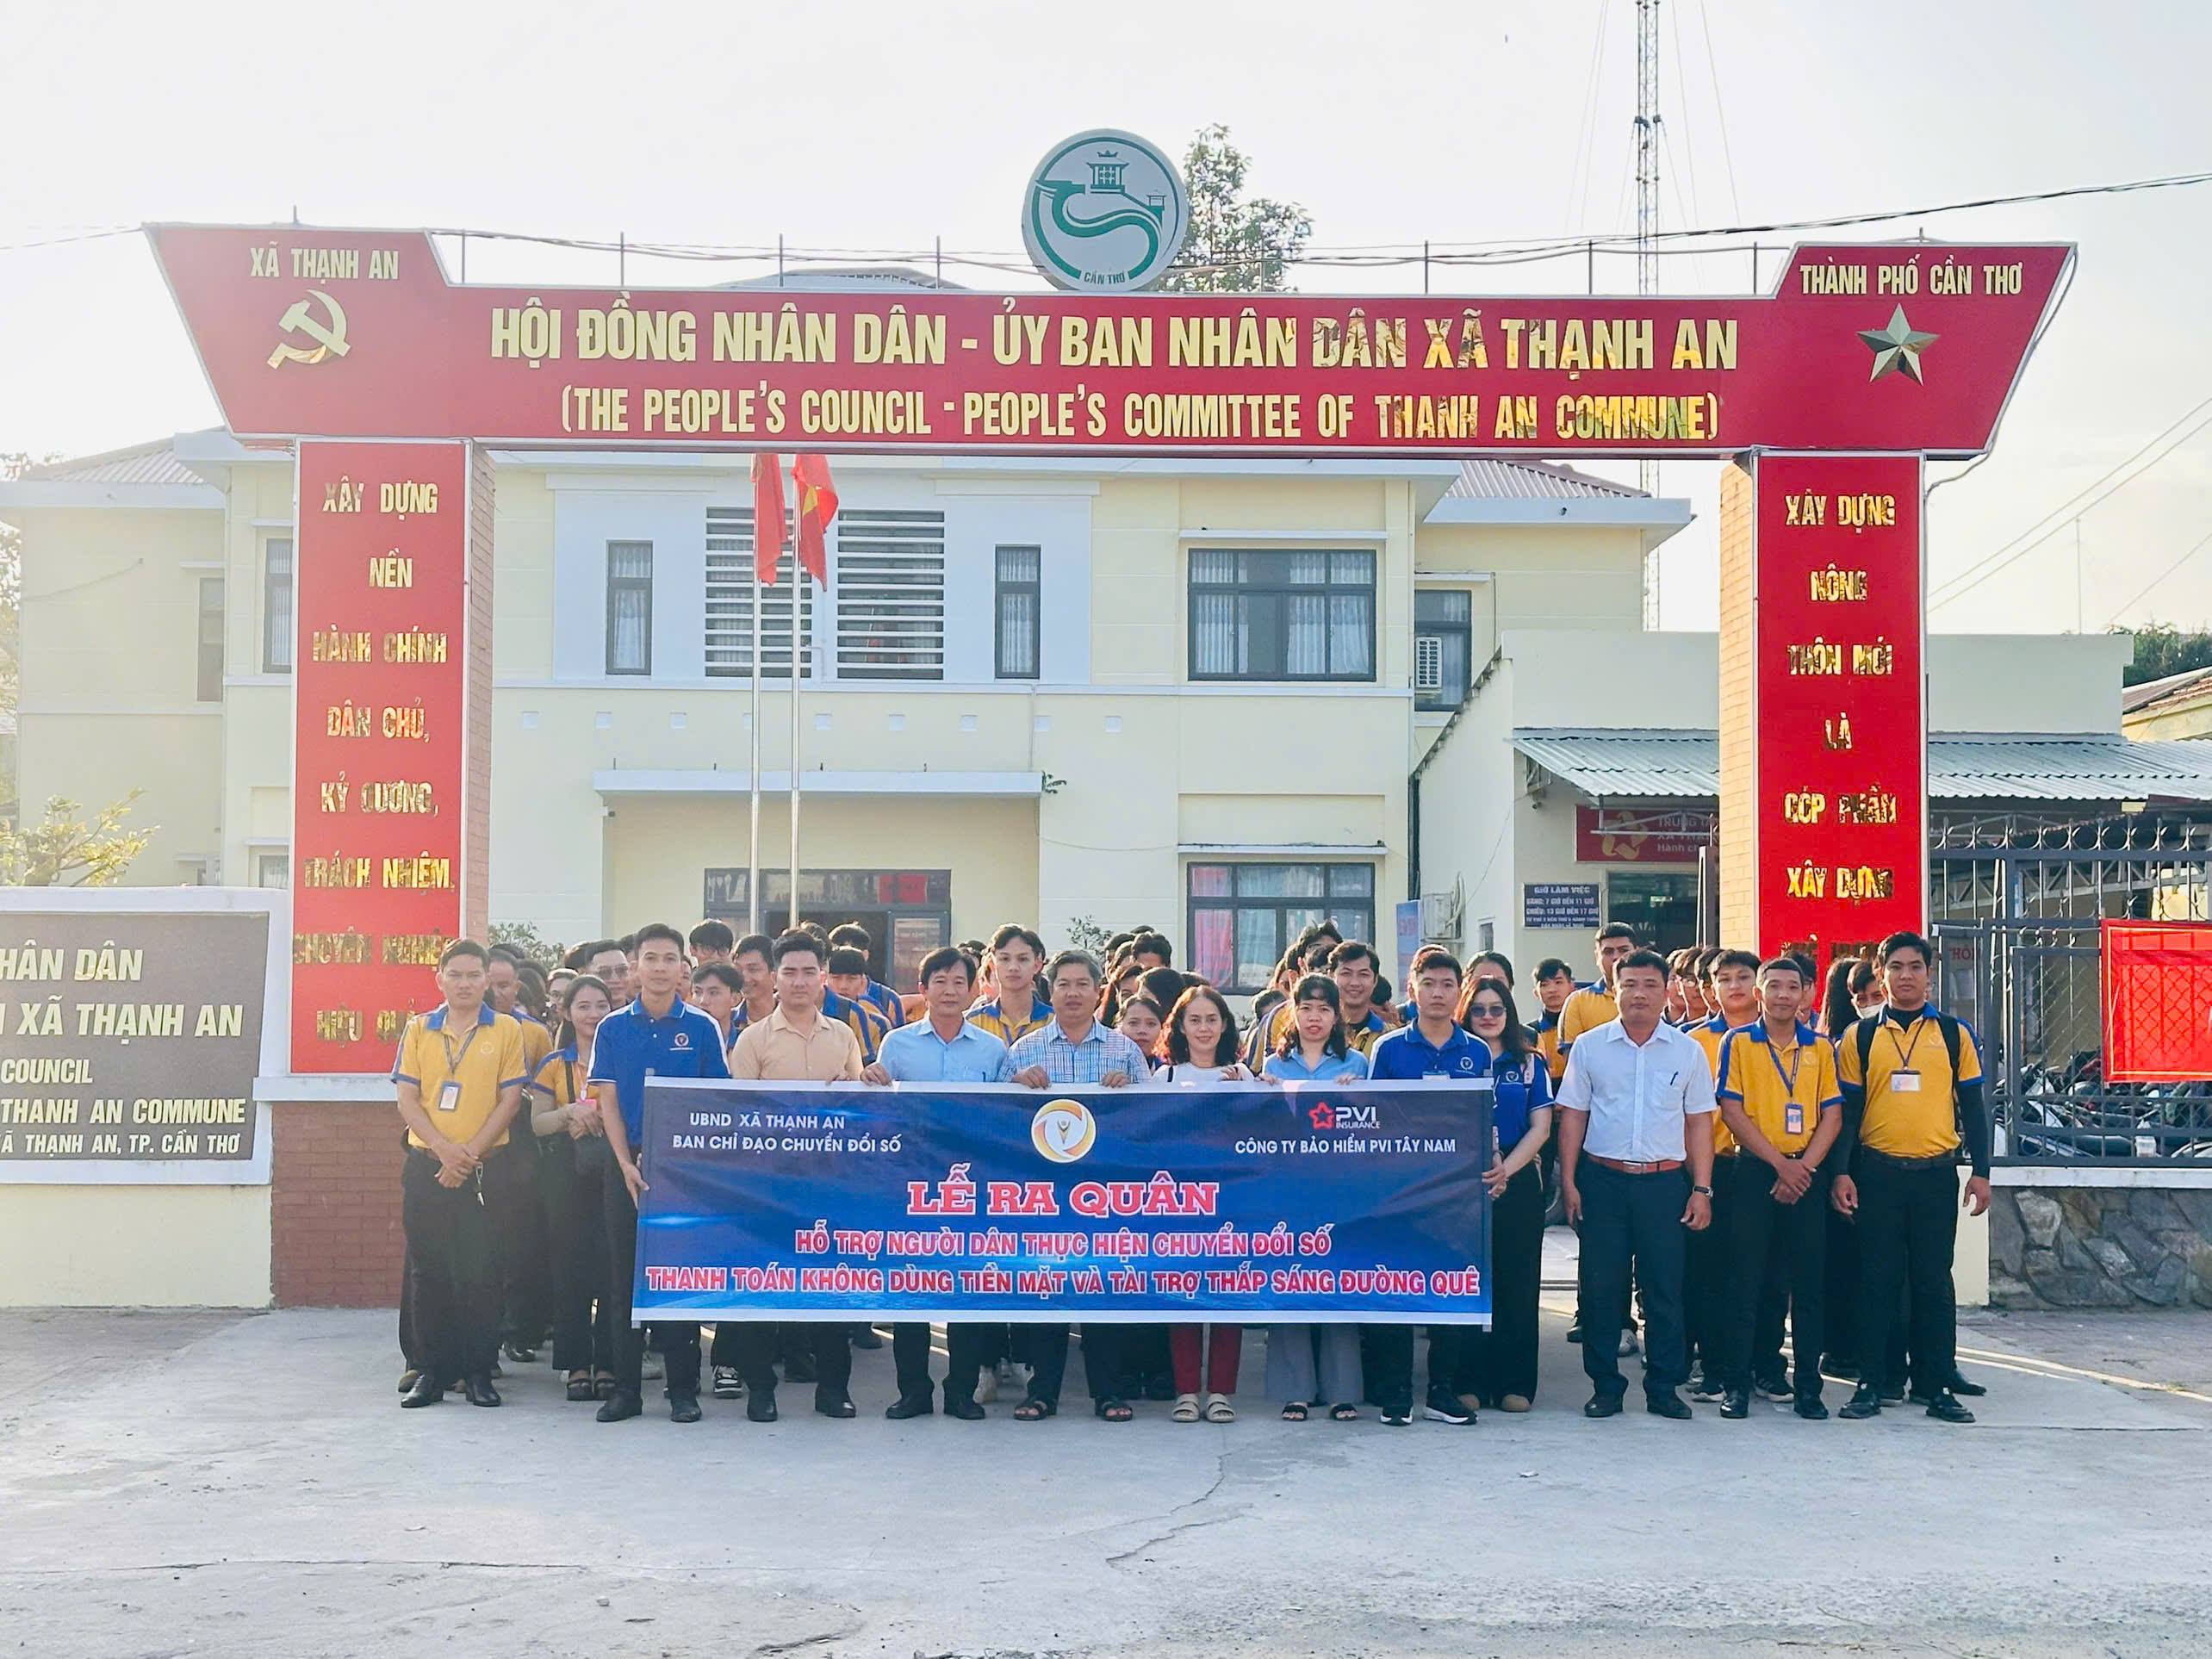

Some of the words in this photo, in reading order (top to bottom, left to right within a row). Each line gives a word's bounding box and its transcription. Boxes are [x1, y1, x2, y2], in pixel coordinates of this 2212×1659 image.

[251, 241, 280, 277] XÃ
[291, 248, 359, 283] THẠNH
[368, 251, 399, 280] AN
[1800, 256, 1867, 295] THÀNH
[1878, 254, 1921, 295] PHỐ
[1929, 255, 1973, 295] CẦN
[1983, 262, 2023, 295] THƠ
[492, 296, 561, 369] HỘI
[576, 291, 696, 362] ĐỒNG
[713, 302, 836, 363] NHÂN
[854, 304, 946, 365] DÂN
[962, 339, 978, 349] -
[993, 297, 1050, 366] ỦY
[1060, 317, 1152, 367] BAN
[1169, 308, 1296, 368] NHÂN
[1313, 308, 1407, 368] DÂN
[1423, 308, 1488, 369] XÃ
[1501, 318, 1653, 380] THẠNH
[1671, 318, 1737, 370] AN
[562, 384, 628, 432] (THE
[644, 381, 786, 433] PEOPLE'S
[801, 389, 930, 435] COUNCIL
[964, 384, 1107, 436] PEOPLE'S
[1124, 394, 1301, 438] COMMITTEE
[1318, 393, 1354, 438] OF
[1375, 395, 1479, 439] THANH
[1494, 395, 1538, 439] AN
[1556, 392, 1718, 441] COMMUNE)
[322, 475, 364, 513] XÂY
[380, 480, 438, 520] DỰNG
[1785, 488, 1827, 526] XÂY
[1837, 493, 1896, 534] DỰNG
[370, 547, 413, 587] NỀN
[1810, 562, 1867, 601] NÔNG
[313, 623, 371, 662] HÀNH
[384, 625, 447, 663] CHÍNH
[1787, 636, 1842, 675] THÔN
[1852, 636, 1893, 674] MỚI
[327, 699, 371, 737] DÂN
[1824, 711, 1853, 750] LÀ
[321, 771, 349, 813] KỶ
[303, 849, 371, 888] TRÁCH
[1786, 859, 1827, 898] XÂY
[74, 940, 144, 981] DÂN
[382, 927, 458, 972] NGHIỆ
[16, 995, 63, 1035] XÃ
[76, 1003, 184, 1045] THẠNH
[195, 1004, 243, 1036] AN
[1, 1059, 93, 1084] COUNCIL
[1, 1098, 78, 1124] THANH
[90, 1099, 123, 1124] AN
[133, 1098, 246, 1123] COMMUNE
[690, 1113, 731, 1127] UBND
[739, 1111, 761, 1128] XÃ
[766, 1115, 817, 1132] THẠNH
[823, 1116, 845, 1129] AN
[1336, 1106, 1376, 1122] PVI
[1336, 1121, 1380, 1129] INSURANCE
[0, 1130, 14, 1153] Ã
[26, 1134, 84, 1157] THẠNH
[91, 1134, 121, 1154] AN,
[129, 1134, 154, 1153] TP.
[161, 1129, 198, 1153] CẦN
[207, 1133, 241, 1153] THƠ
[673, 1134, 705, 1148] BAN
[709, 1132, 737, 1150] CHỈ
[743, 1137, 776, 1154] ĐẠO
[782, 1132, 842, 1152] CHUYỂN
[848, 1132, 875, 1153] ĐỔI
[880, 1134, 902, 1153] SỐ
[1235, 1137, 1277, 1154] CÔNG
[1282, 1140, 1296, 1154] TY
[1301, 1135, 1330, 1154] BẢO
[1334, 1133, 1365, 1153] HIỂM
[1370, 1140, 1391, 1153] PVI
[1395, 1136, 1420, 1153] TÂY
[1425, 1140, 1456, 1153] NAM
[907, 1162, 977, 1215] LỄ
[986, 1181, 1059, 1215] RA
[1069, 1170, 1220, 1218] QUÂN
[794, 1219, 830, 1255] HỖ
[834, 1229, 884, 1261] TRỢ
[886, 1227, 965, 1256] NGƯỜI
[969, 1227, 1017, 1257] DÂN
[1022, 1232, 1089, 1261] THỰC
[1092, 1227, 1149, 1262] HIỆN
[1153, 1221, 1248, 1258] CHUYỂN
[1252, 1221, 1295, 1257] ĐỔI
[1298, 1223, 1335, 1257] SỐ
[646, 1265, 728, 1293] THANH
[731, 1261, 796, 1293] TOÁN
[800, 1262, 885, 1295] KHÔNG
[888, 1263, 954, 1294] DÙNG
[959, 1262, 1013, 1294] TIỀN
[1017, 1265, 1067, 1301] MẶT
[1072, 1265, 1104, 1294] VÀ
[1108, 1265, 1147, 1294] TÀI
[1151, 1270, 1202, 1300] TRỢ
[1207, 1260, 1267, 1294] THẮP
[1271, 1264, 1335, 1294] SÁNG
[1339, 1264, 1426, 1295] ĐƯỜNG
[1430, 1264, 1481, 1299] QUÊ
